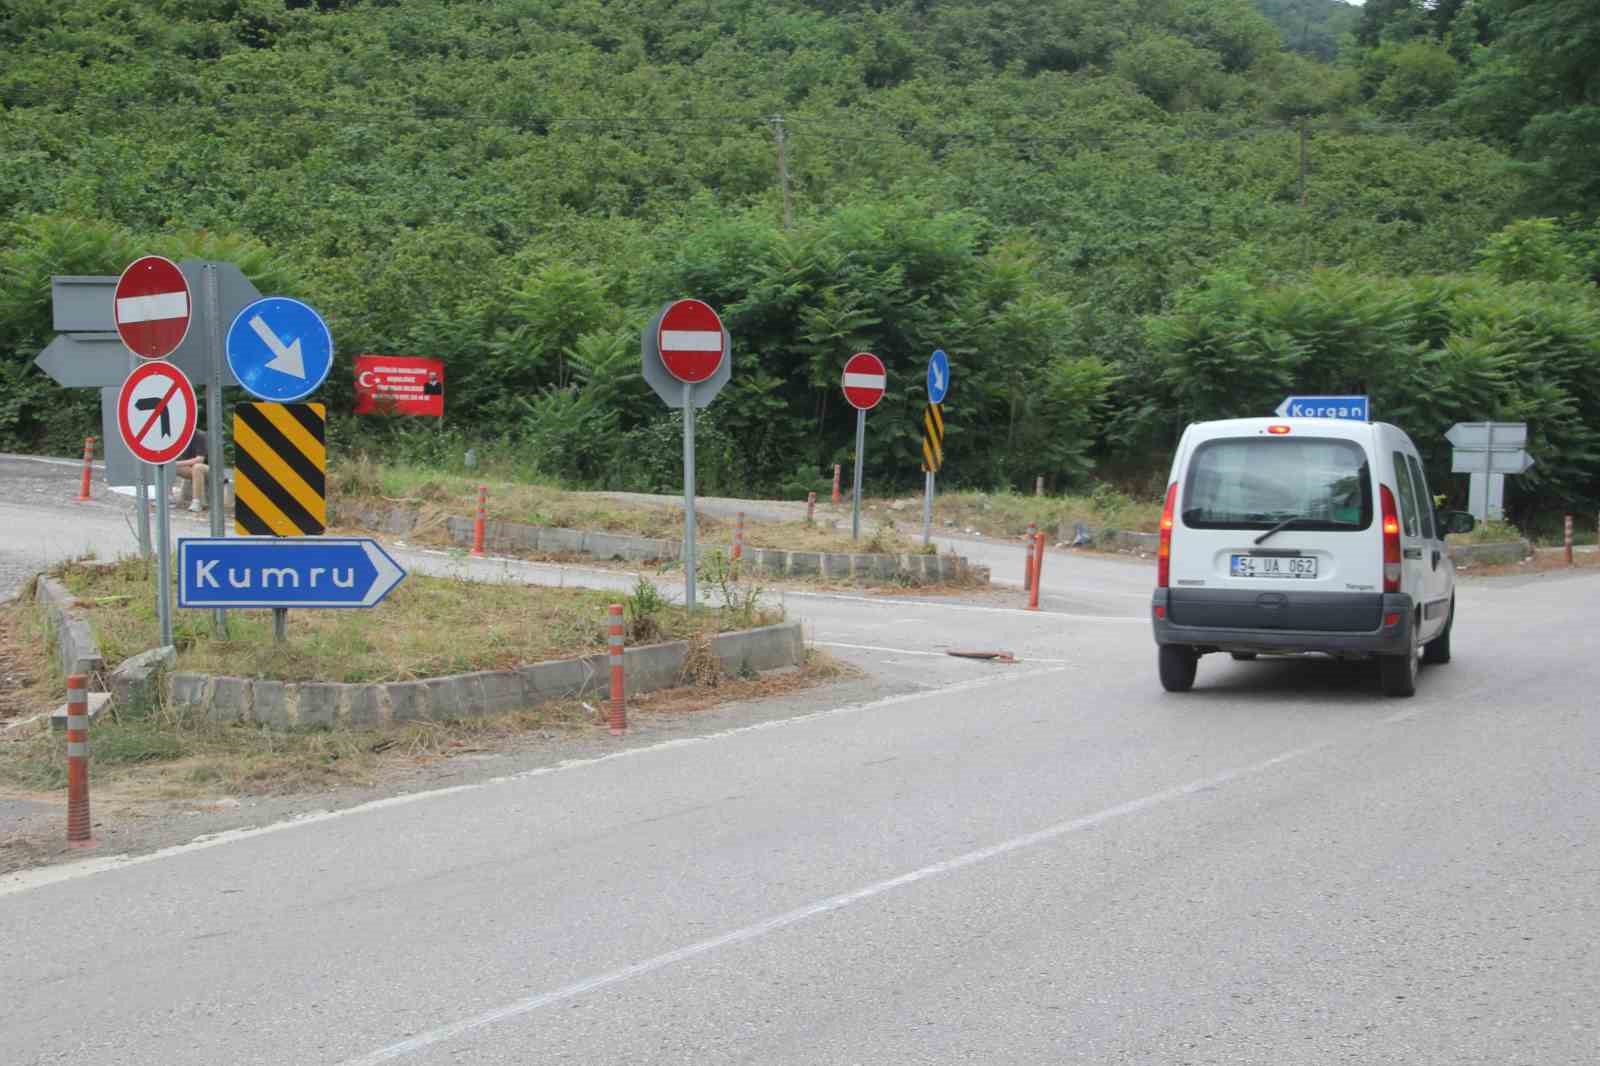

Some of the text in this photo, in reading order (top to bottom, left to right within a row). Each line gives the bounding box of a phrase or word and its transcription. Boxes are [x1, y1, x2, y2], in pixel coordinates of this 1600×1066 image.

[1292, 404, 1361, 419] Korgan
[1239, 558, 1313, 573] 54 UA 062
[196, 559, 354, 588] Kumru
